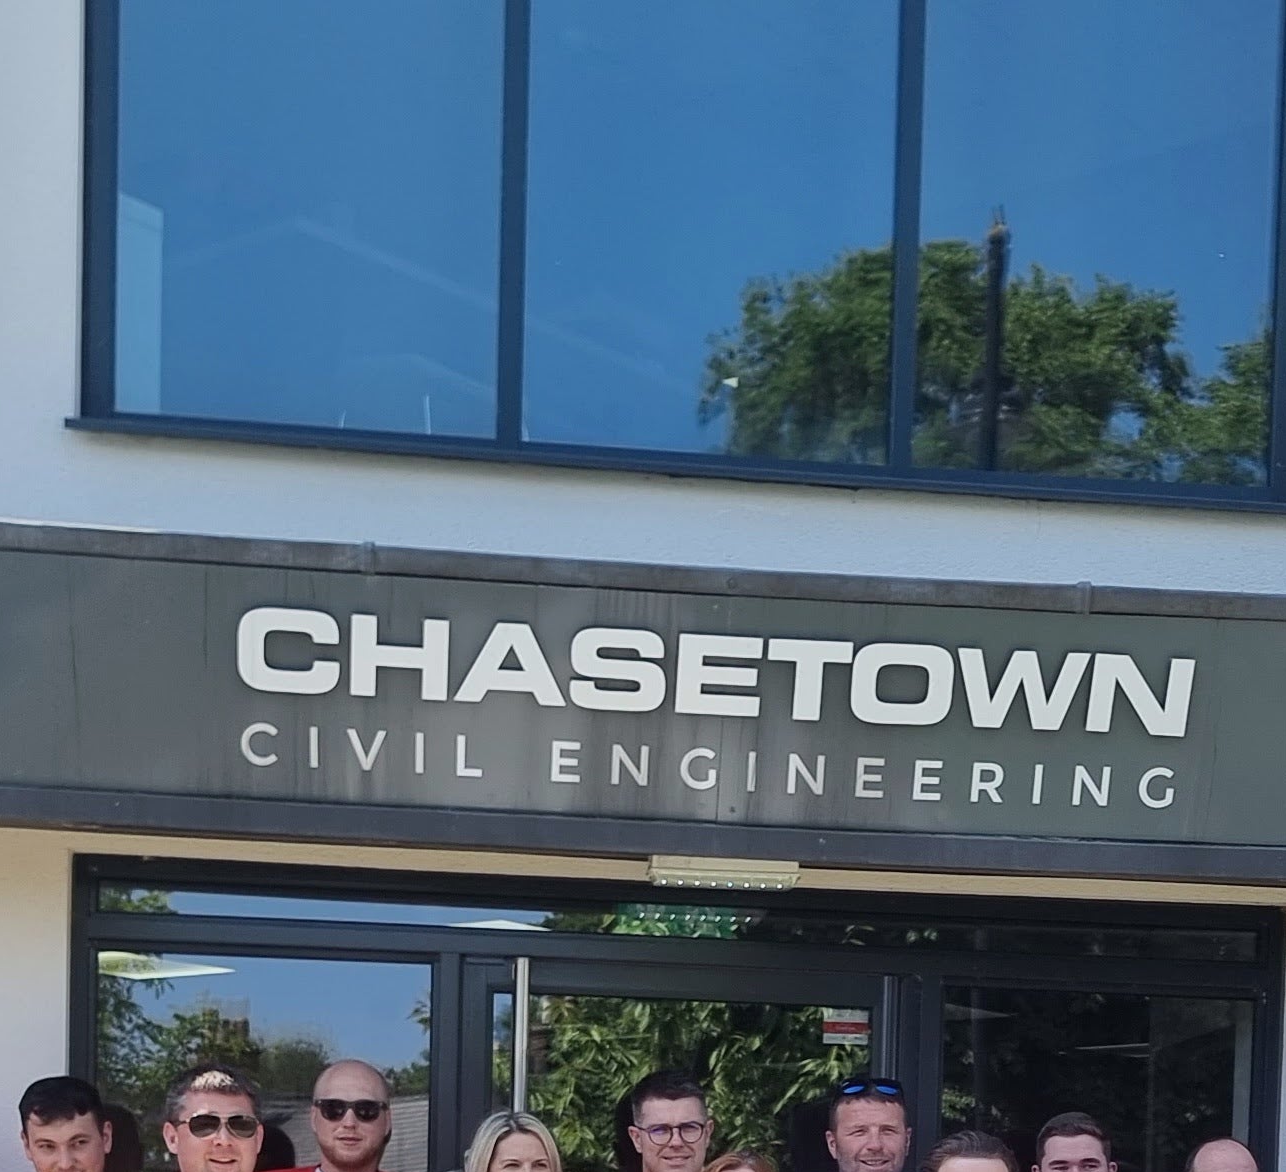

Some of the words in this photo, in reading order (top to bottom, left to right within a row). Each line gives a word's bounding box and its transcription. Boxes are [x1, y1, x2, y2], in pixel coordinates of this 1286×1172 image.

[237, 606, 1196, 737] CHASETOWN
[240, 722, 483, 778] CIVIL
[549, 739, 1176, 810] ENGINEERING
